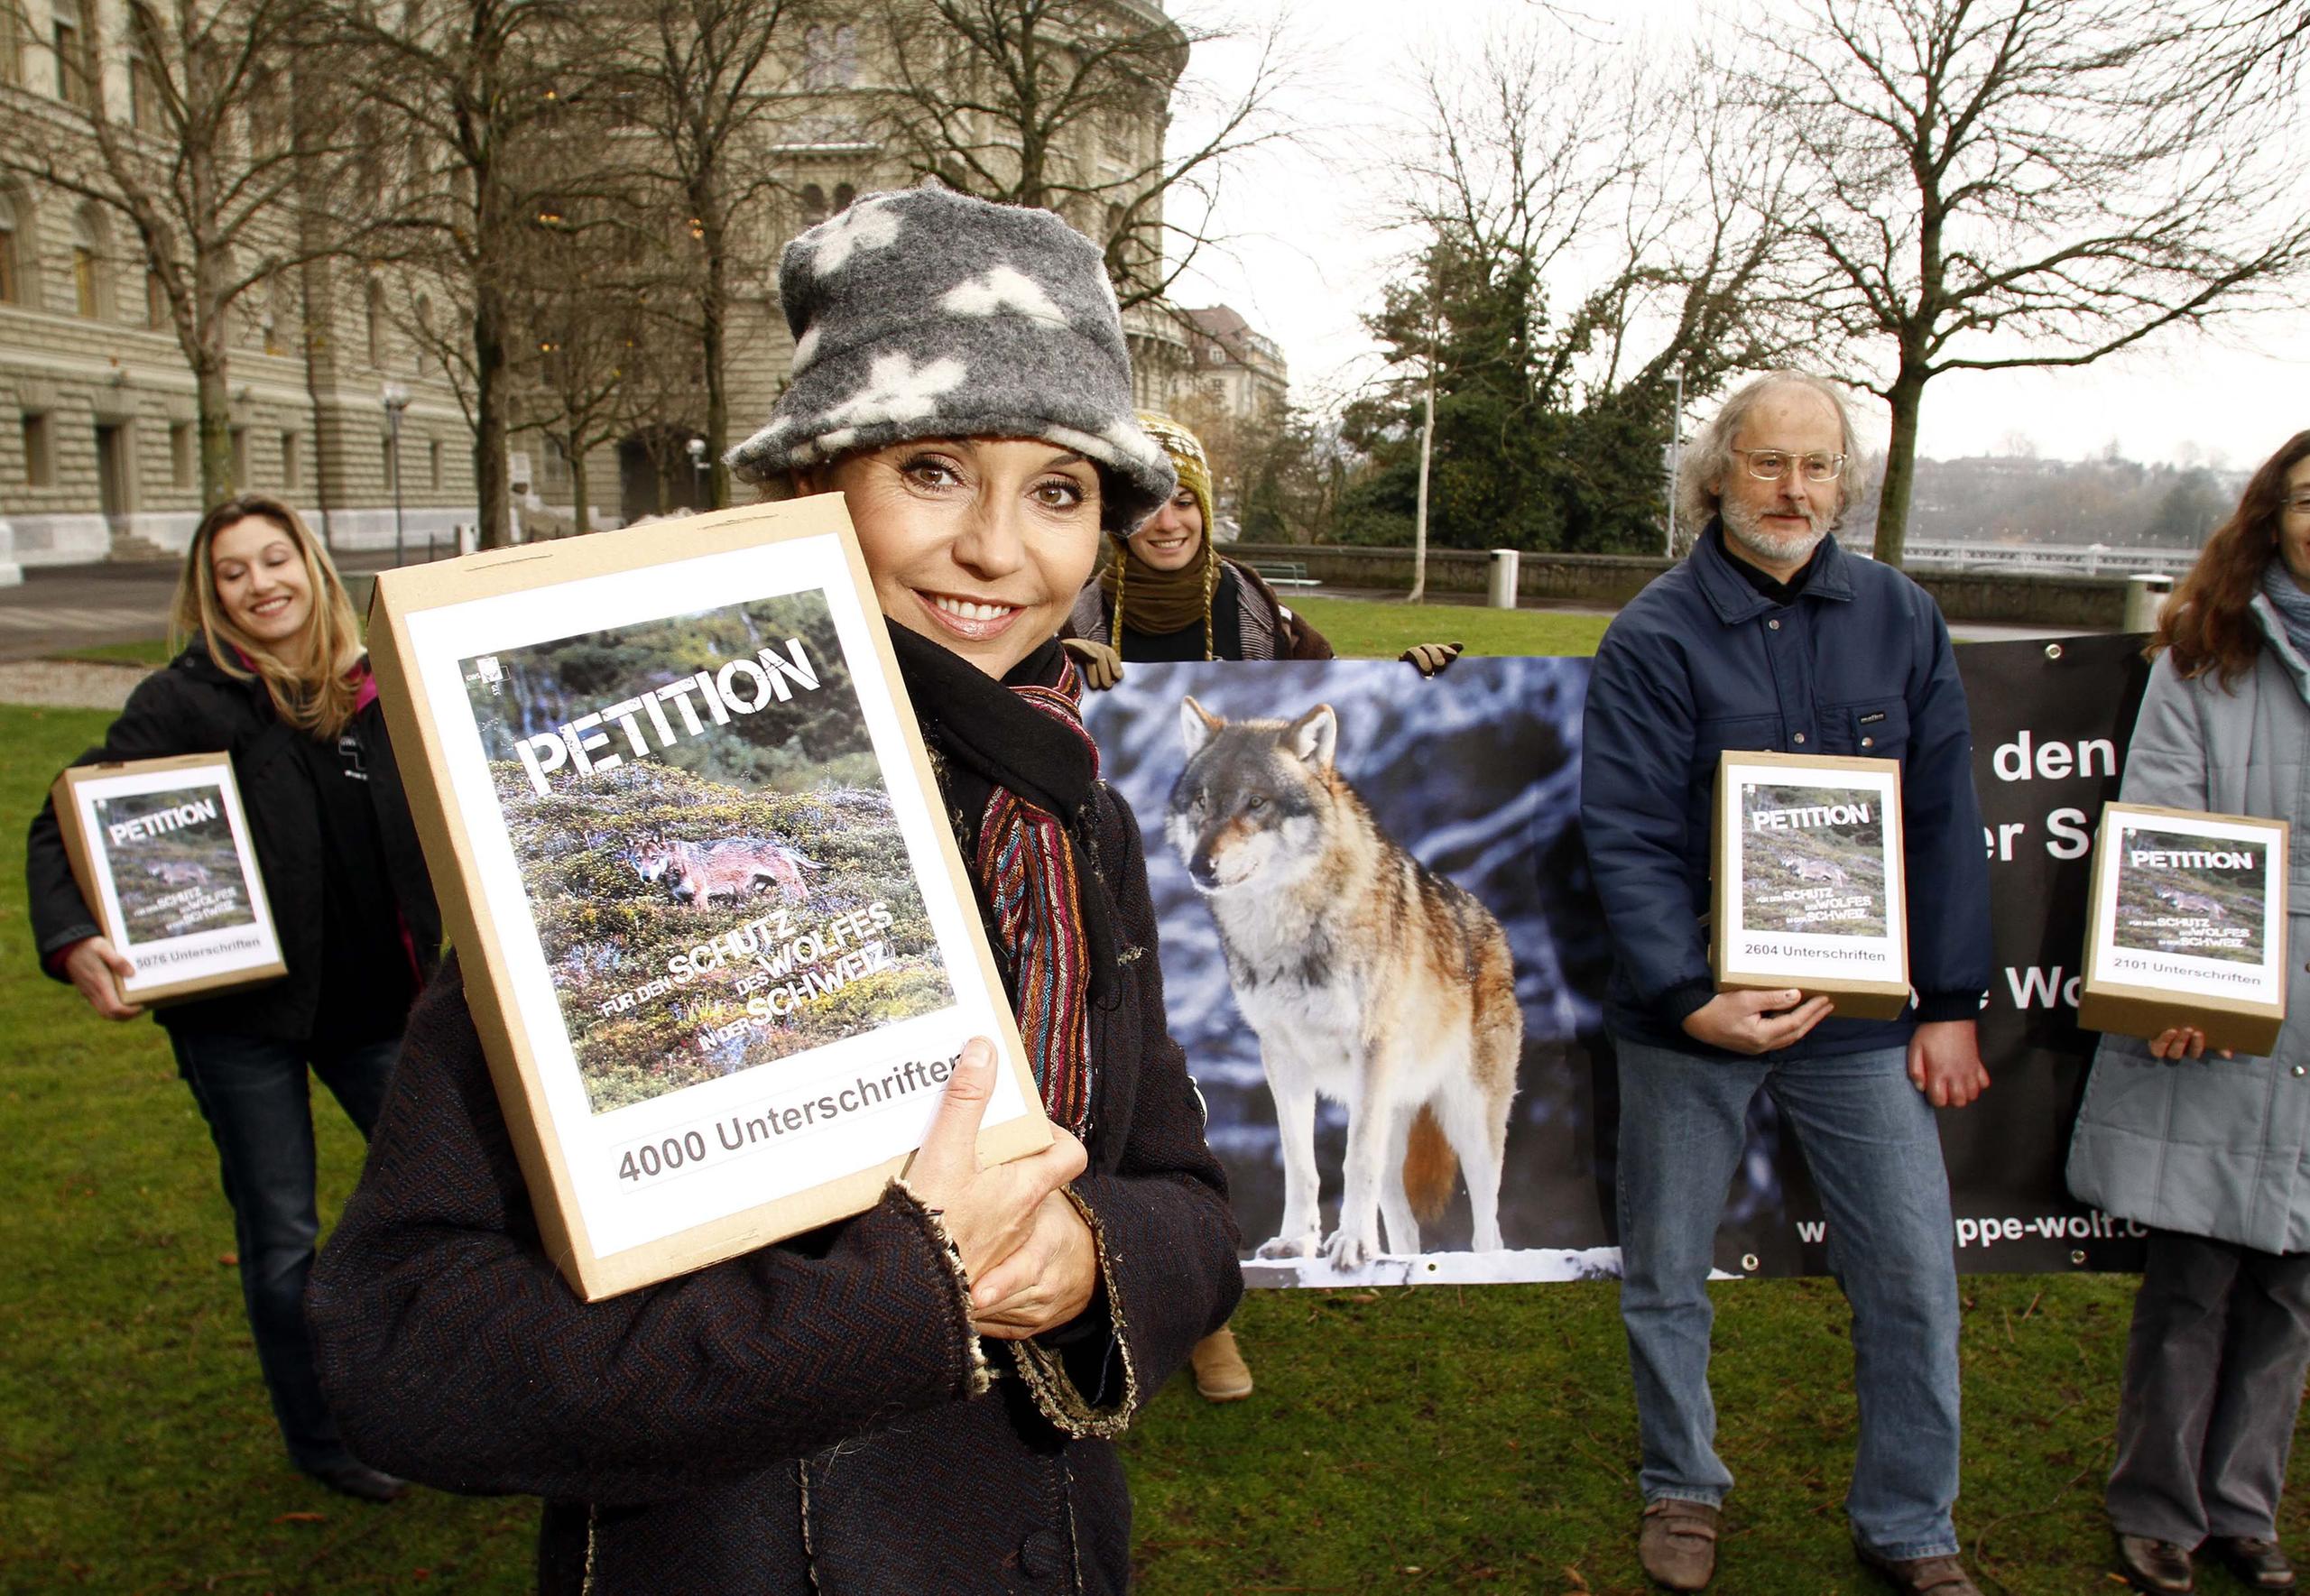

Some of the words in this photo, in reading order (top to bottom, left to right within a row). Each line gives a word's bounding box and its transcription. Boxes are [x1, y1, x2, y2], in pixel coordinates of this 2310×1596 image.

[513, 637, 821, 797] PETITION
[1992, 730, 2116, 781] den
[108, 798, 217, 847] PETITION
[1751, 803, 1870, 831] PETITION
[2046, 807, 2098, 860] S
[2130, 850, 2253, 870] PETITION
[1783, 888, 1834, 900] SCHUTZ
[1816, 896, 1872, 909] WOLFES
[1806, 908, 1867, 922] SCHWEIZ
[2157, 917, 2210, 927] SCHUTZ
[2191, 927, 2250, 938] WOLFES
[170, 938, 261, 963] Unterschriften
[602, 993, 636, 1018] FÜR
[637, 976, 672, 1005] DEN
[668, 908, 798, 984] SCHUTZ
[735, 973, 769, 997] DES
[757, 901, 894, 980] WOLFES
[1745, 944, 1779, 955] 2604
[1783, 946, 1886, 961] Unterschriften
[2113, 957, 2147, 970] 2101
[2153, 962, 2261, 985] Unterschriften
[698, 1029, 719, 1052] IN
[719, 1018, 753, 1043] DER
[746, 940, 892, 1027] SCHWEIZ
[619, 1130, 707, 1184] 4000
